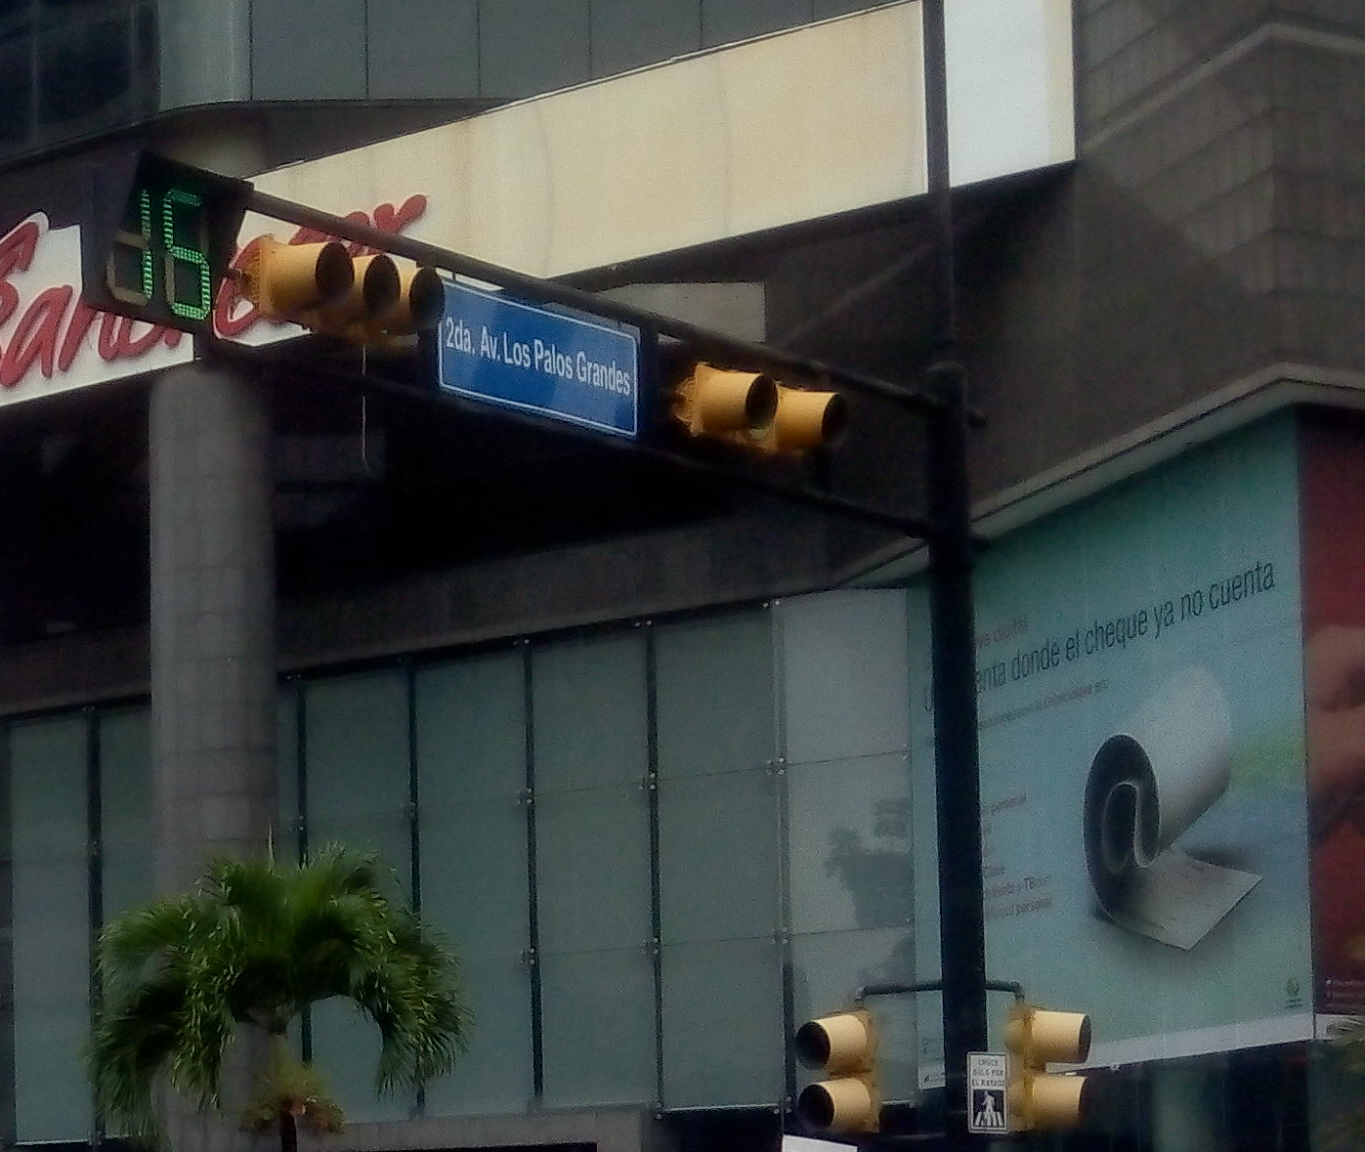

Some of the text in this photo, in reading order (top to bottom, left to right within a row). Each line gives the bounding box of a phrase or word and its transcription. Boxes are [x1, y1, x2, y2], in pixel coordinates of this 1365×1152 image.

[139, 188, 211, 320] 16
[446, 317, 631, 396] 2da. Av. Los Palos Grandes
[1012, 642, 1061, 681] donde
[1066, 629, 1080, 661] el
[1085, 609, 1148, 655] cheque
[1154, 601, 1174, 639] ya
[1181, 590, 1204, 622] no
[1209, 561, 1275, 610] cuenta
